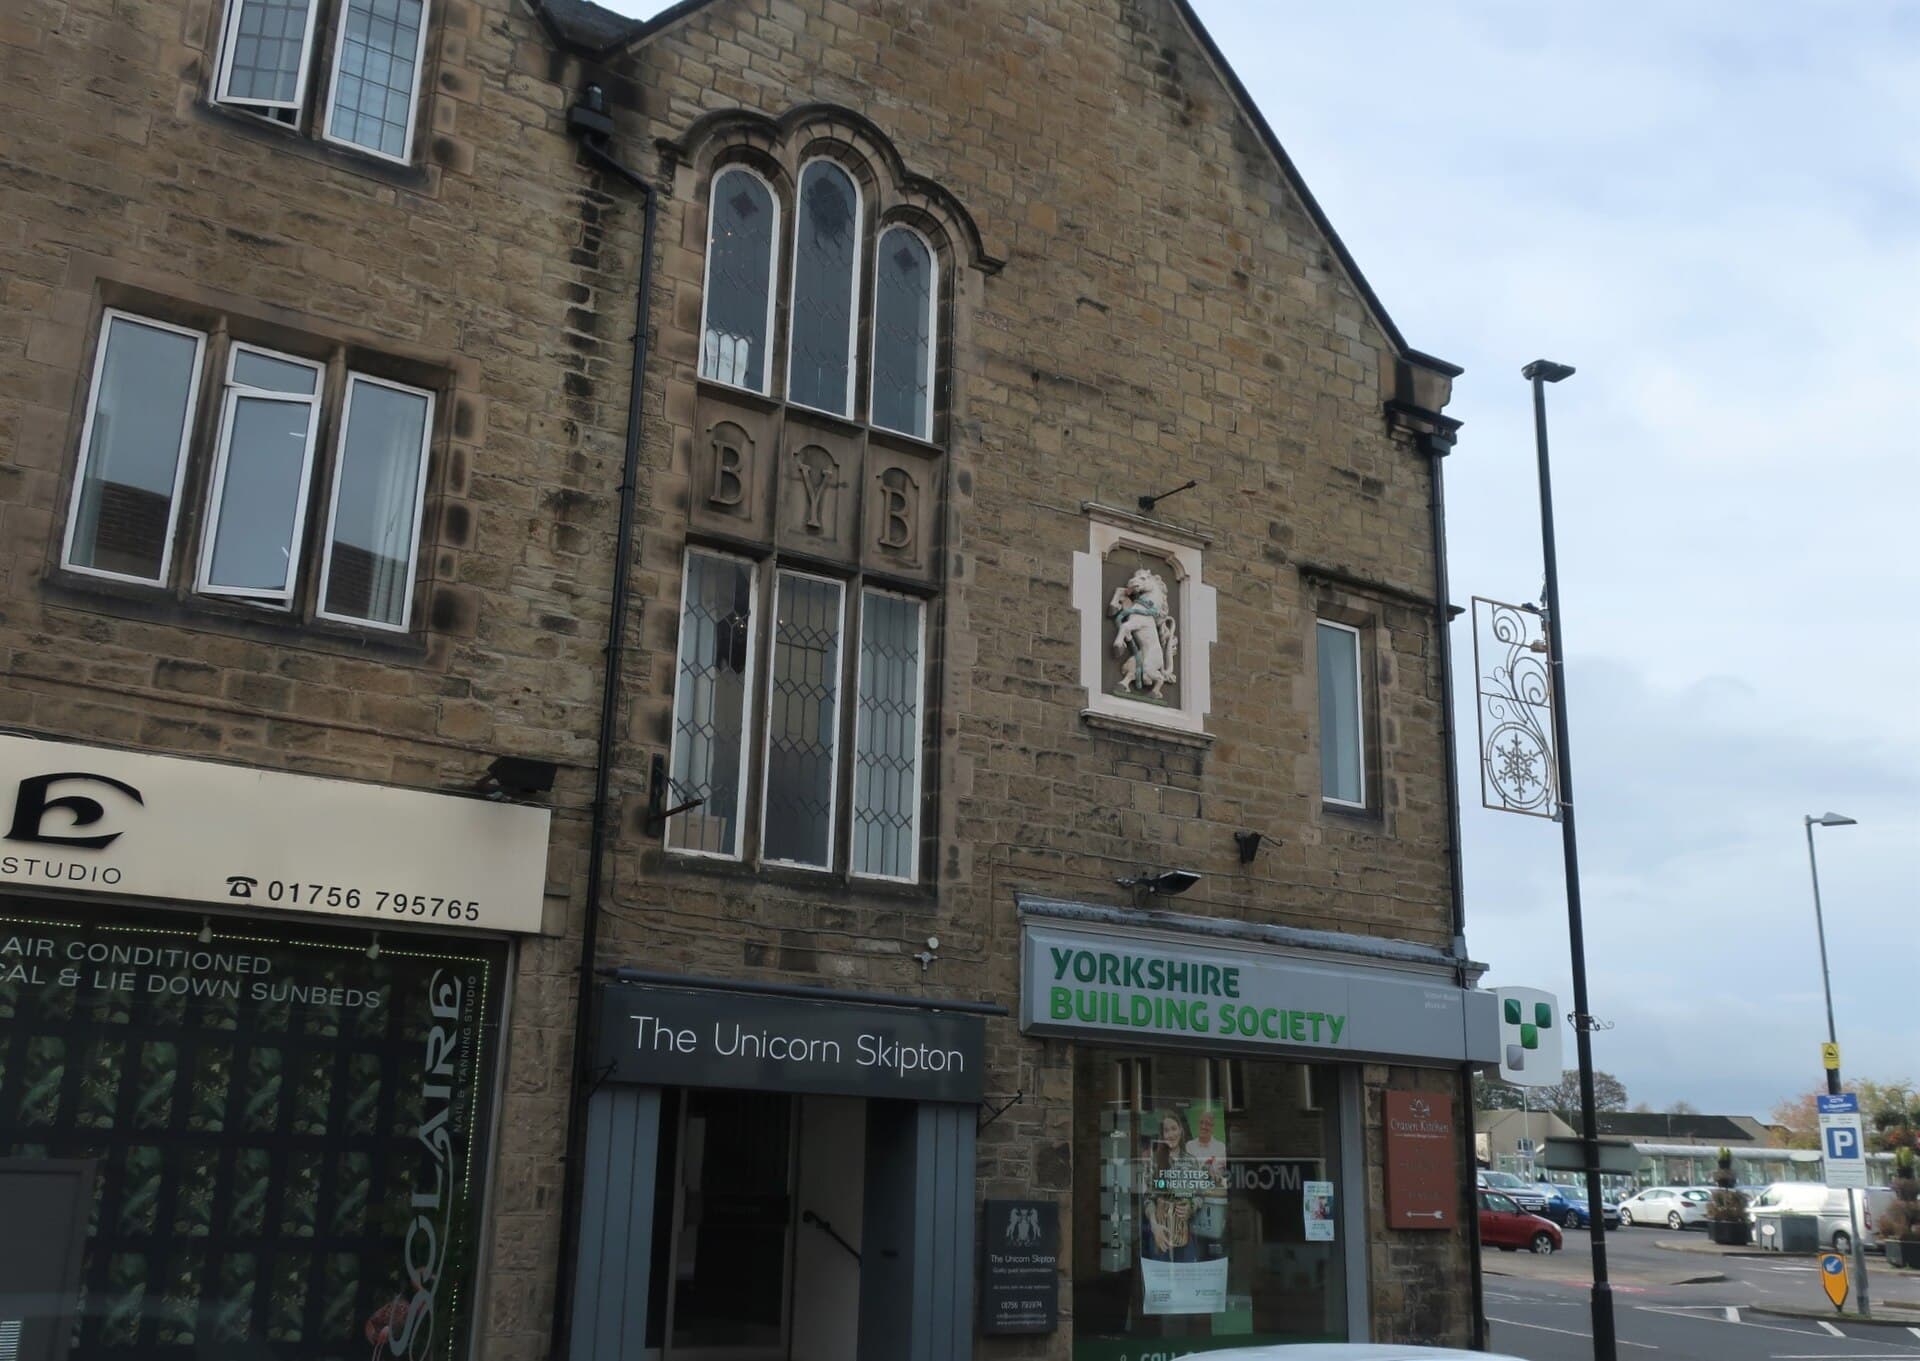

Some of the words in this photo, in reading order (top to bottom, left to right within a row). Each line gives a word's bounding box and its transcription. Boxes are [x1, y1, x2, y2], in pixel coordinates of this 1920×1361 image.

[710, 439, 744, 505] B
[799, 463, 833, 528] Y
[879, 485, 913, 548] B
[1, 857, 121, 884] STUDIO
[268, 881, 361, 909] 01756
[375, 892, 480, 921] 795765
[0, 936, 54, 958] AIR
[67, 942, 271, 974] CONDITIONED
[1050, 947, 1240, 998] YORKSHIRE
[58, 968, 81, 986] &
[94, 971, 136, 991] LIE
[147, 975, 240, 998] DOWN
[251, 982, 381, 1008] SUNBEDS
[464, 975, 477, 1022] STUDIO
[1050, 986, 1209, 1032] BUILDING
[1218, 1003, 1346, 1044] SOCIETY
[458, 1027, 472, 1083] TANNING
[630, 1015, 697, 1053] The
[715, 1022, 840, 1063] Unicorn
[856, 1034, 964, 1077] Skipton
[388, 968, 462, 1360] SOLAIRE
[1833, 1131, 1854, 1157] P
[1153, 1179, 1165, 1188] TO
[1166, 1179, 1187, 1189] NEXT
[1189, 1180, 1216, 1190] STEPS
[1159, 1169, 1181, 1179] FIRST
[1183, 1170, 1209, 1179] STEPS
[991, 1254, 1003, 1263] The
[1005, 1255, 1030, 1263] Unicorn
